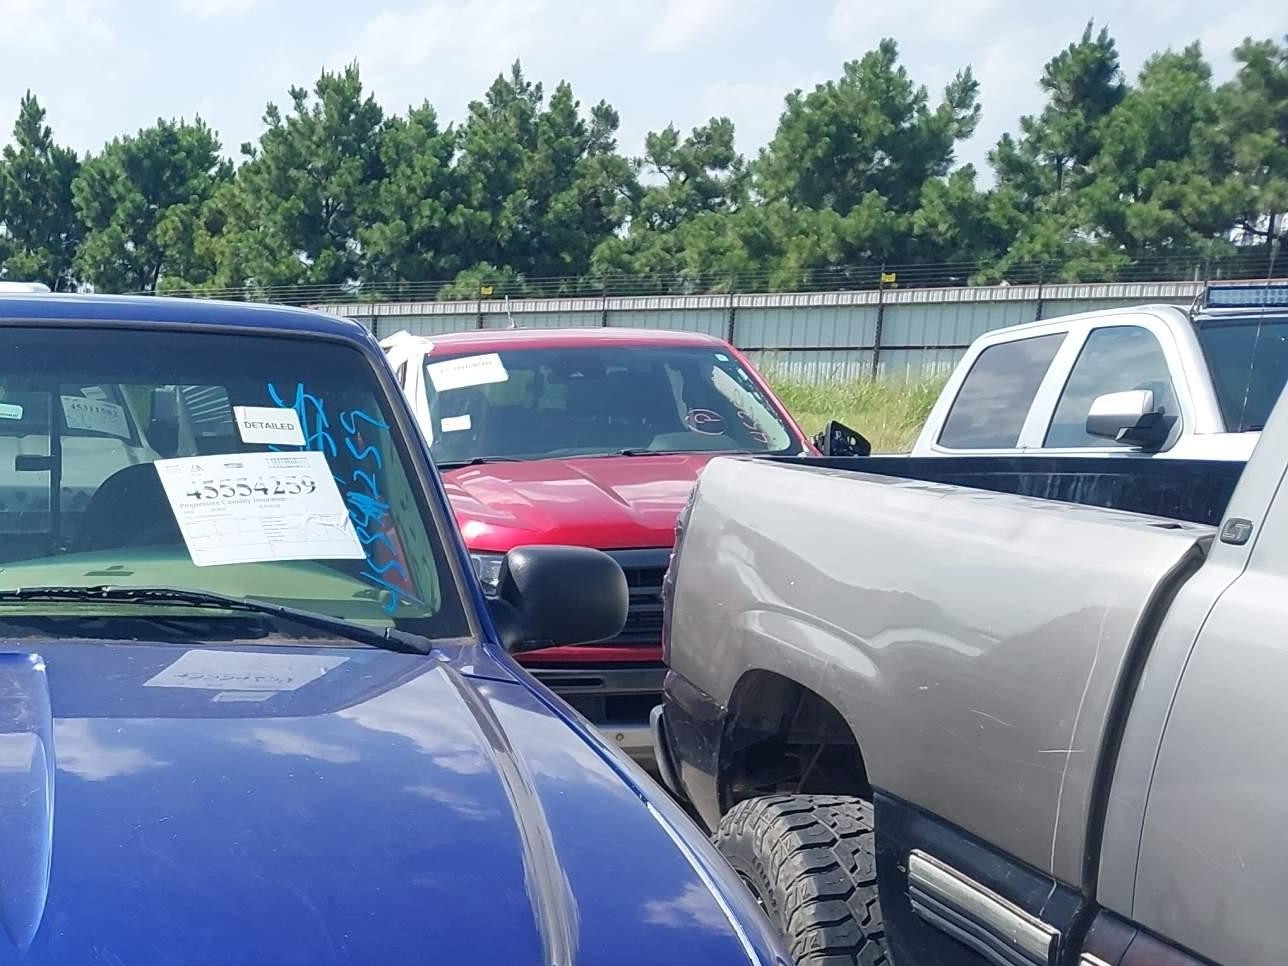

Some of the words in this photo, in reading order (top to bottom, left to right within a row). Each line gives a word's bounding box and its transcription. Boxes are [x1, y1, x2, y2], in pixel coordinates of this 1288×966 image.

[243, 420, 295, 432] DETAILED
[186, 475, 316, 499] 45554259
[1222, 522, 1251, 539] LT
